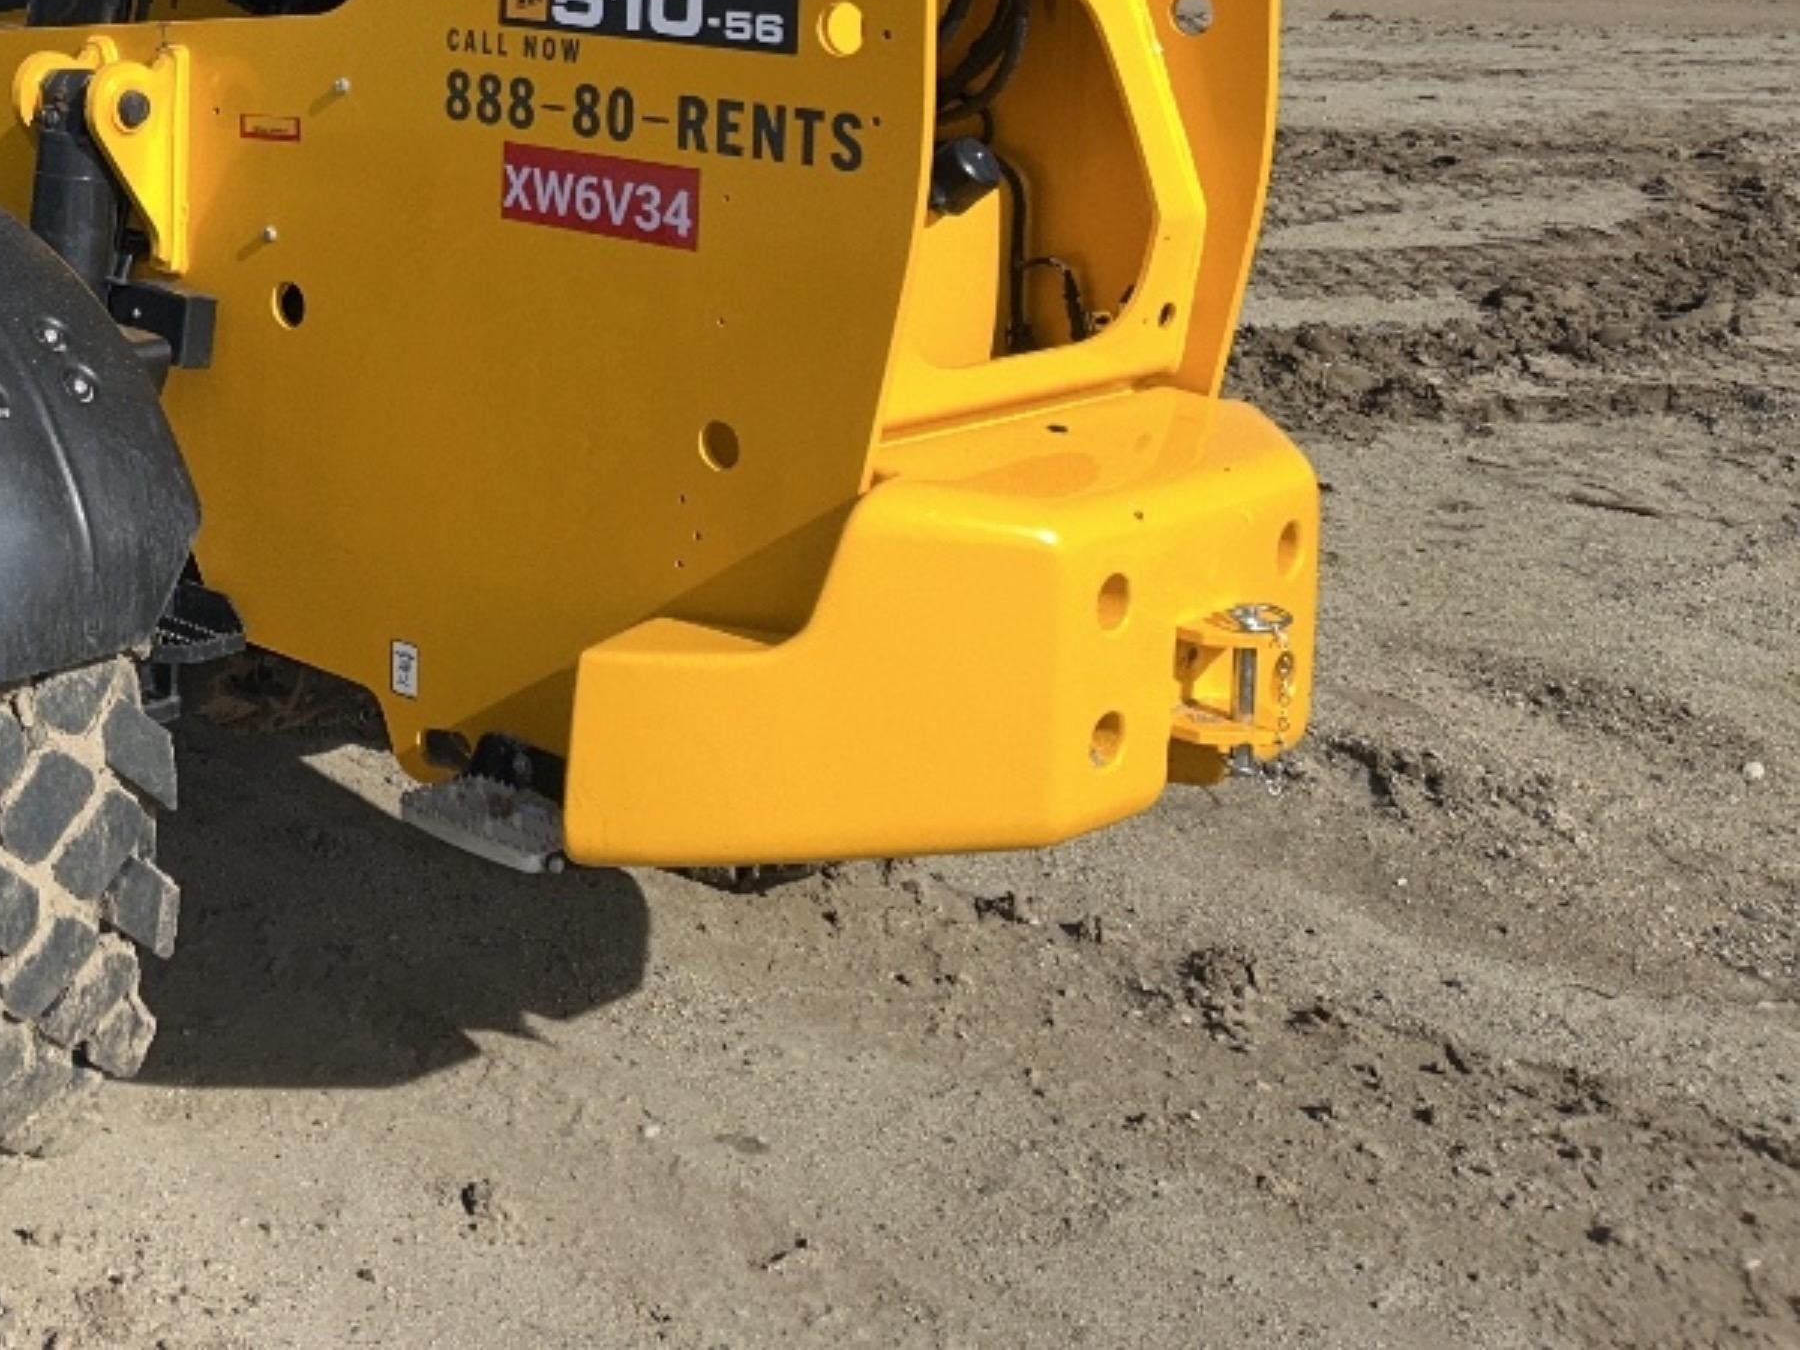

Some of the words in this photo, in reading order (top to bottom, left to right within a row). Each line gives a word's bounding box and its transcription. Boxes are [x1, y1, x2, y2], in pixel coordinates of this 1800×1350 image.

[446, 28, 508, 57] CALL
[523, 35, 582, 65] NOW
[444, 68, 864, 172] 888-80-RENTS
[503, 163, 692, 238] XW6V34
